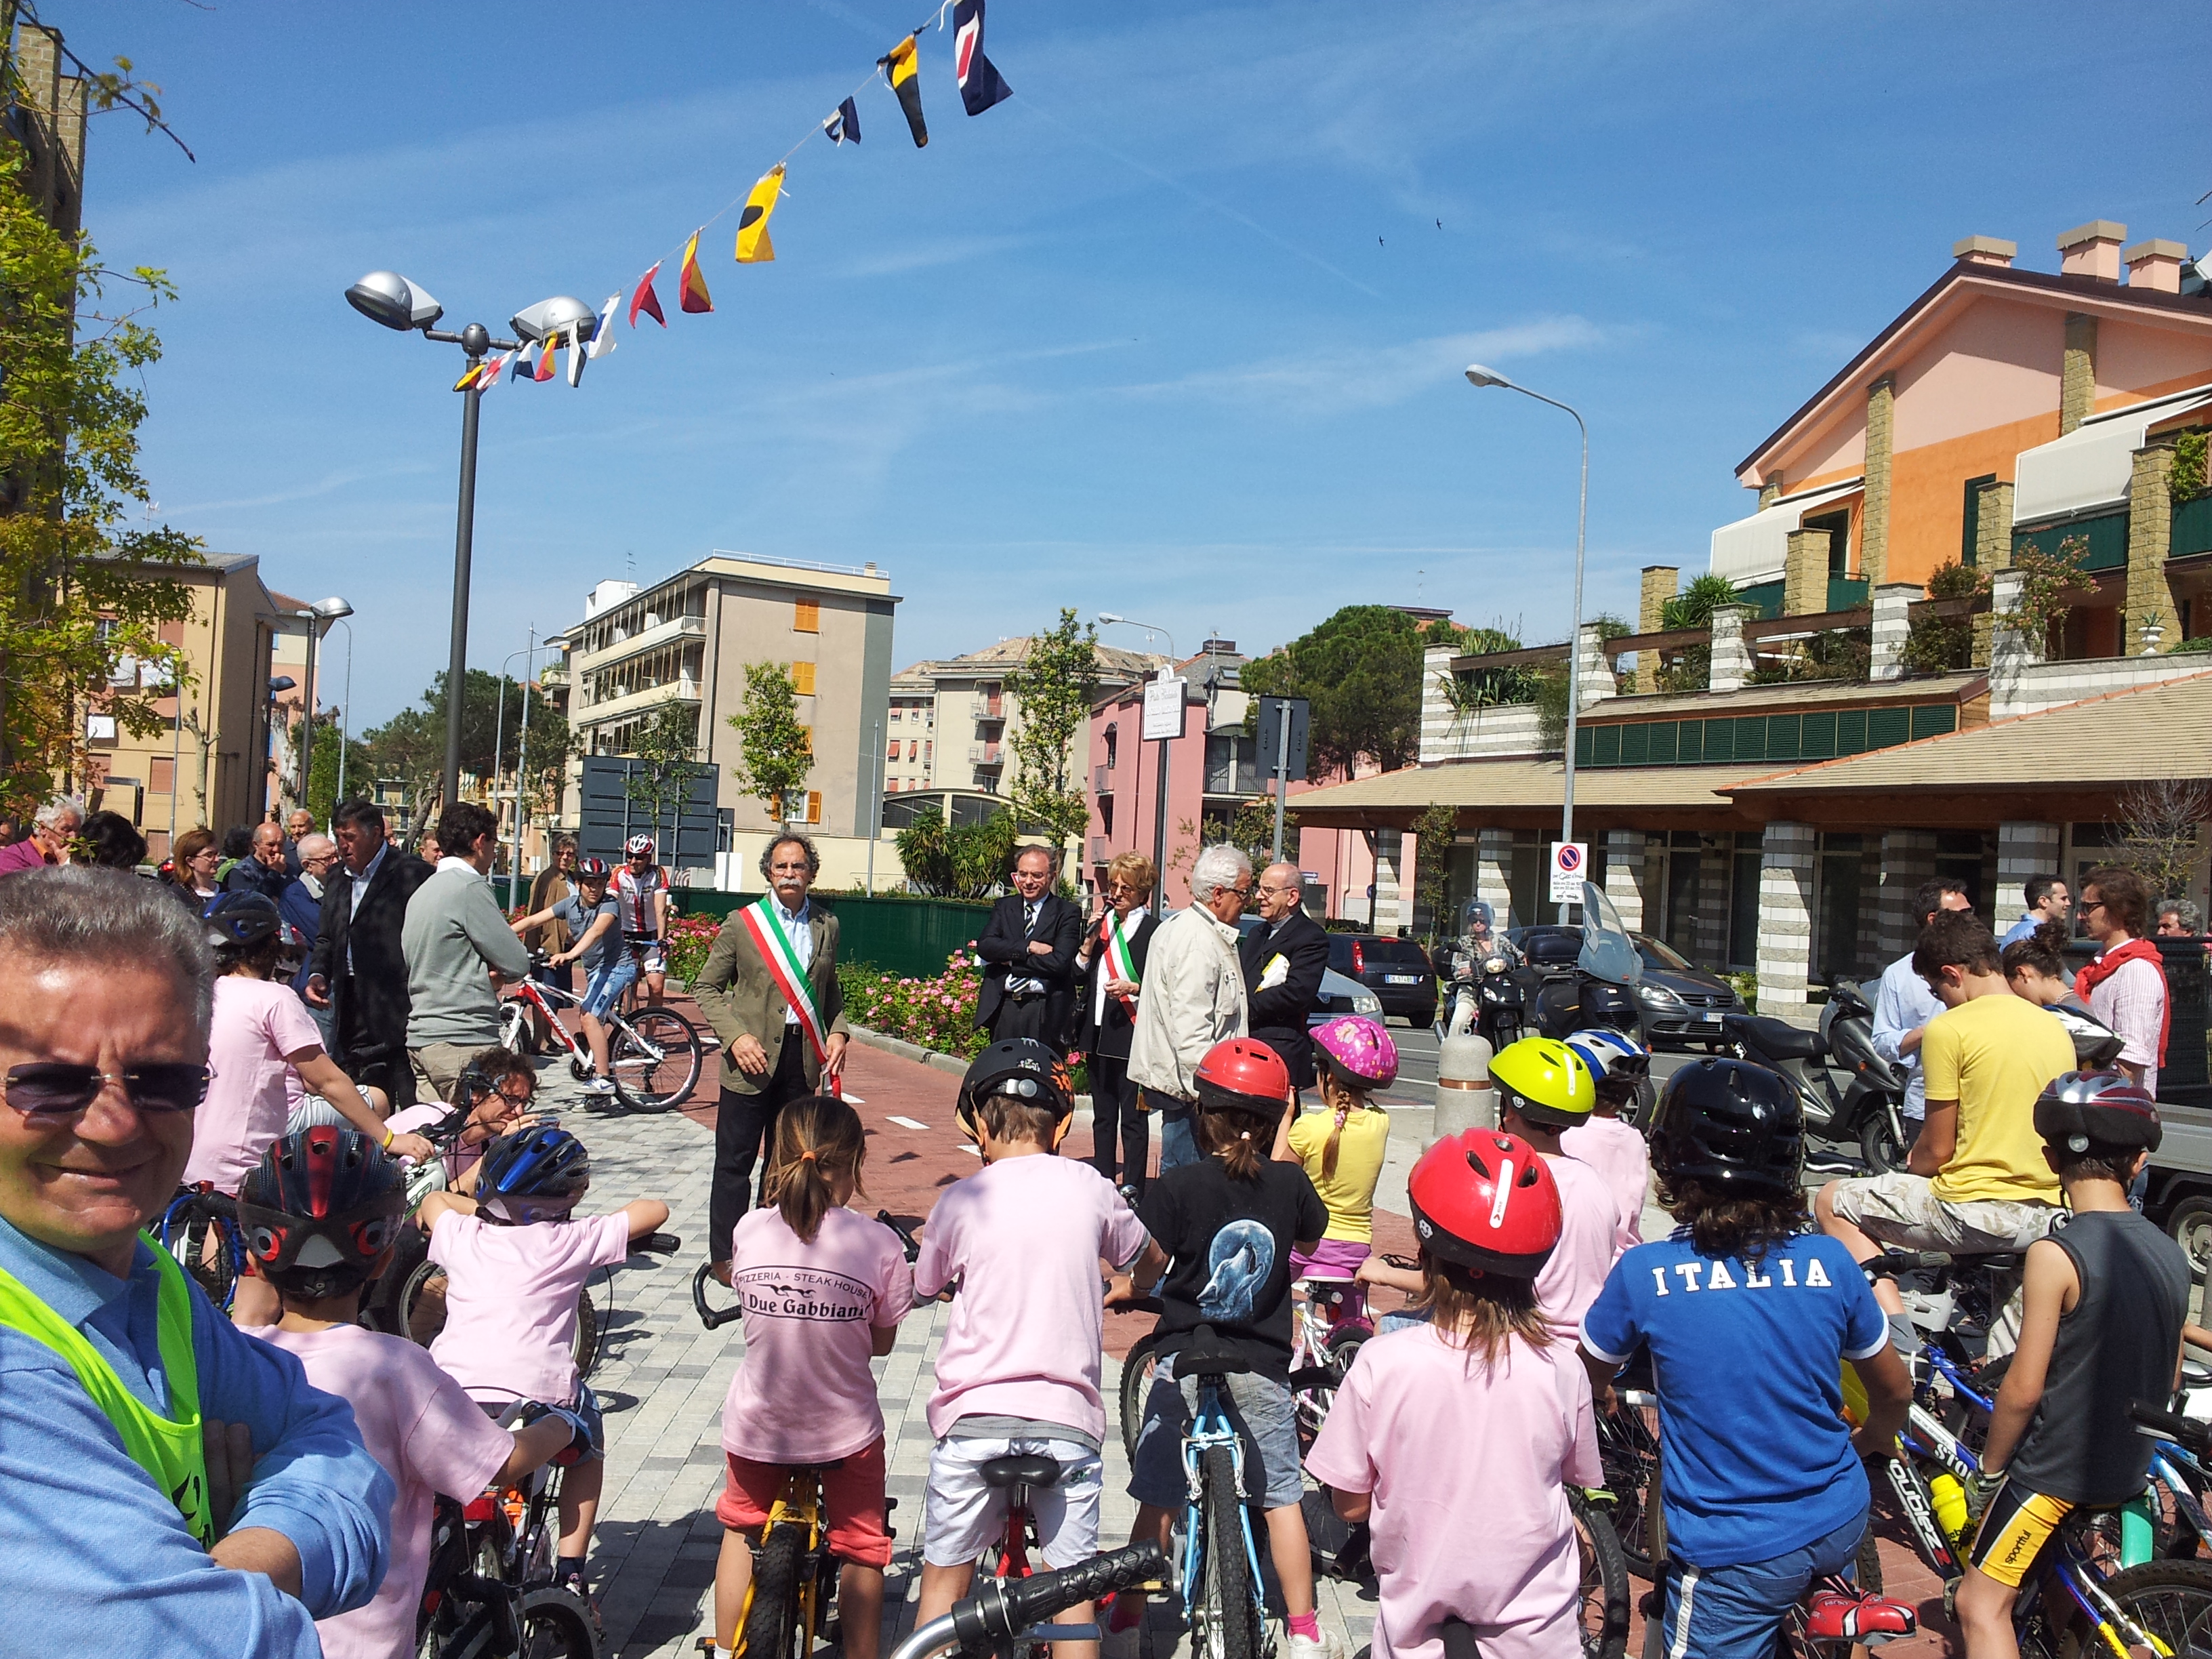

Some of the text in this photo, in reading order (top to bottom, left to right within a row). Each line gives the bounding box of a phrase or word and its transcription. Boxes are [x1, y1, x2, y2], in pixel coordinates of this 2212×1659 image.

[739, 1272, 781, 1284] PIZZERIA
[794, 1273, 832, 1286] STEAK
[834, 1279, 869, 1299] HOUSE
[1652, 1258, 1832, 1297] ITALIA
[749, 1293, 777, 1313] Due
[783, 1298, 865, 1318] Gabbiani
[2004, 1529, 2032, 1565] sportful
